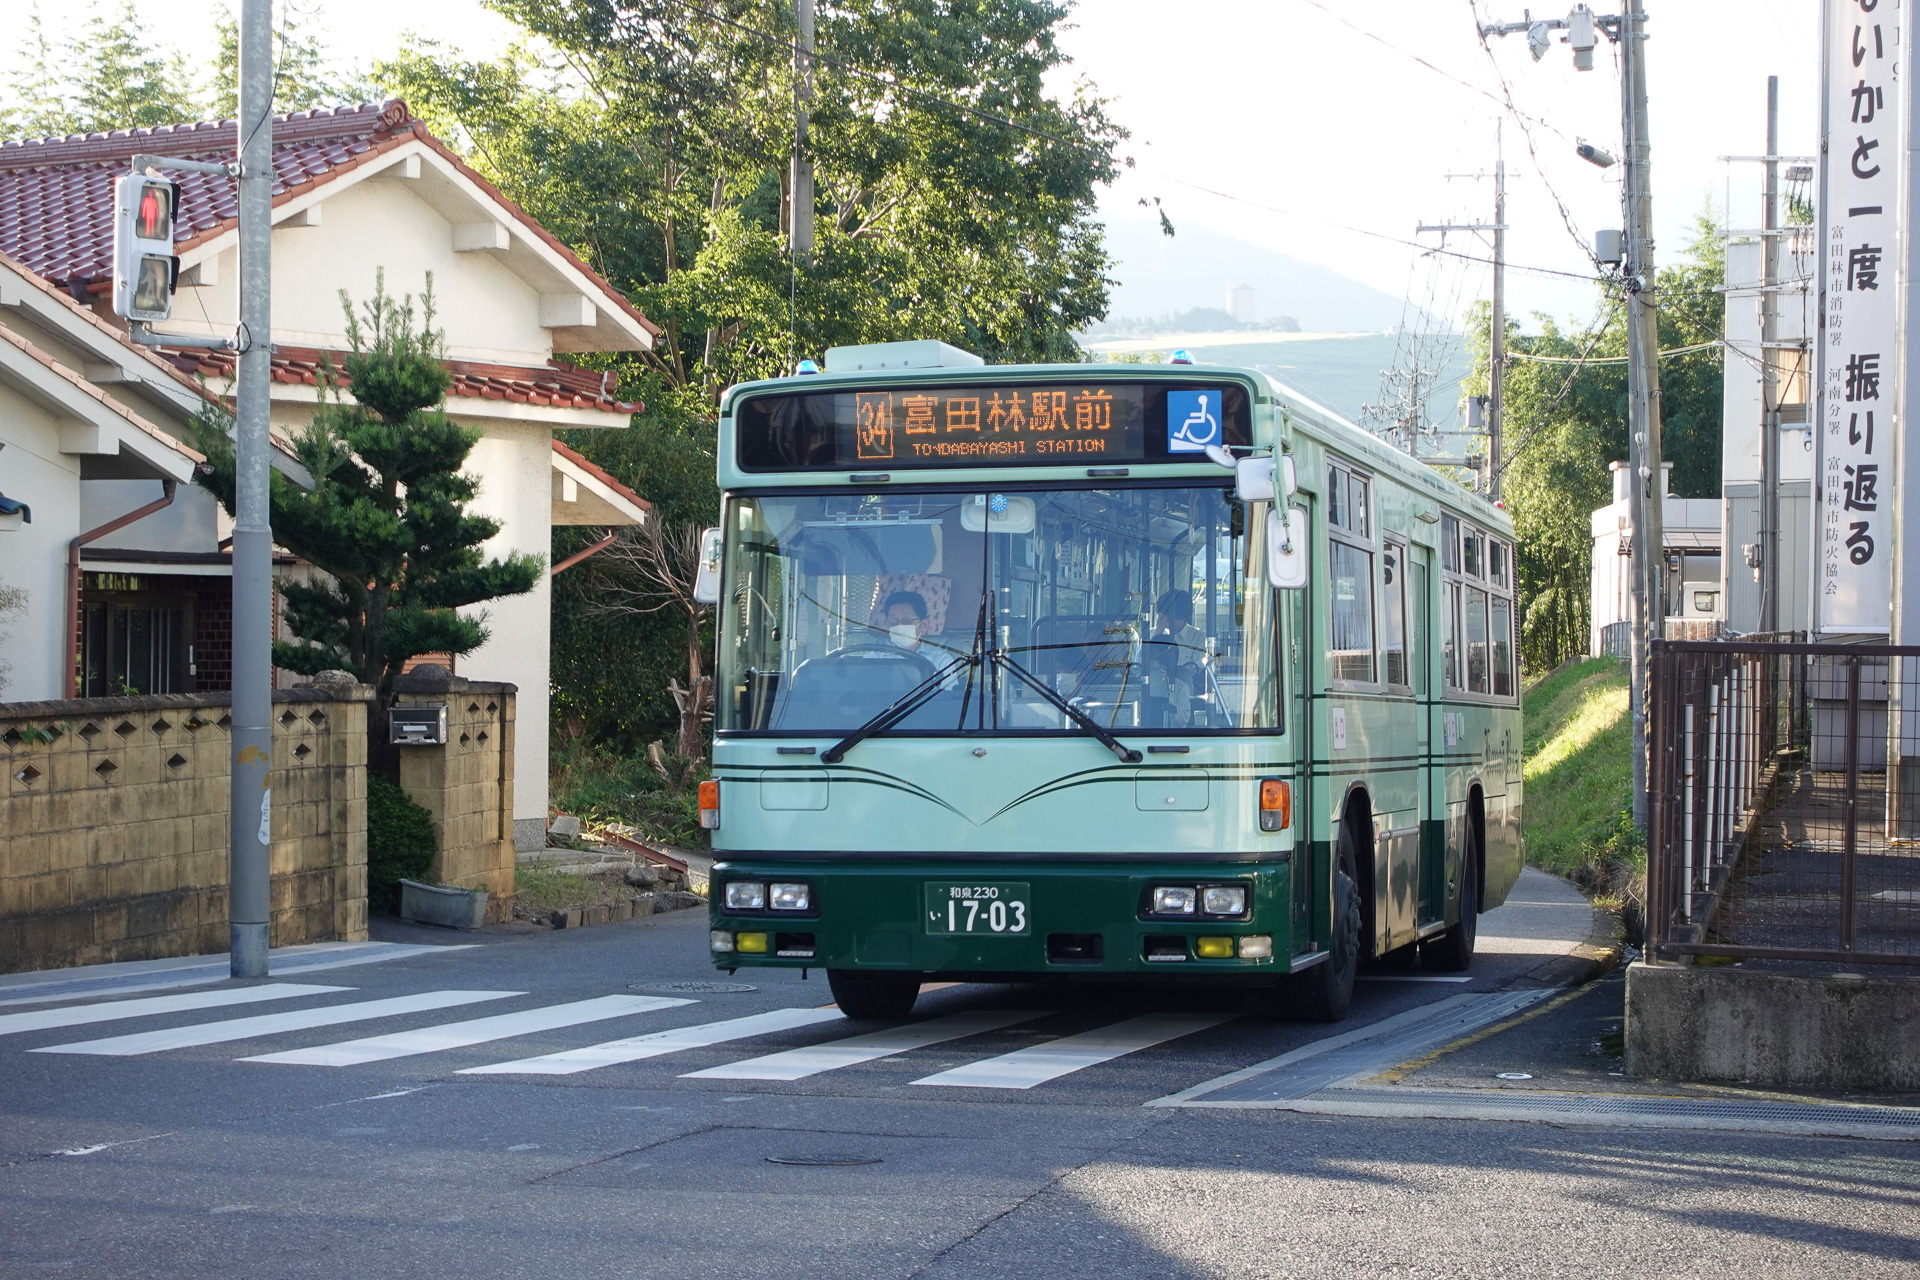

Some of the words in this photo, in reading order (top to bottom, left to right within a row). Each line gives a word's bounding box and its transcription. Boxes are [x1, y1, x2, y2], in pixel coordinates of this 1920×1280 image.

[1829, 225, 1844, 347] 富田林市消防署
[861, 401, 888, 446] 34
[902, 389, 1113, 434] 富田林駅前
[1828, 367, 1842, 435] 河南分署
[1036, 438, 1106, 454] STATION
[1843, 353, 1881, 566] 振り返る
[1824, 456, 1841, 596] 富田林市防火協会
[929, 910, 941, 921] い
[948, 900, 1026, 932] 17-03
